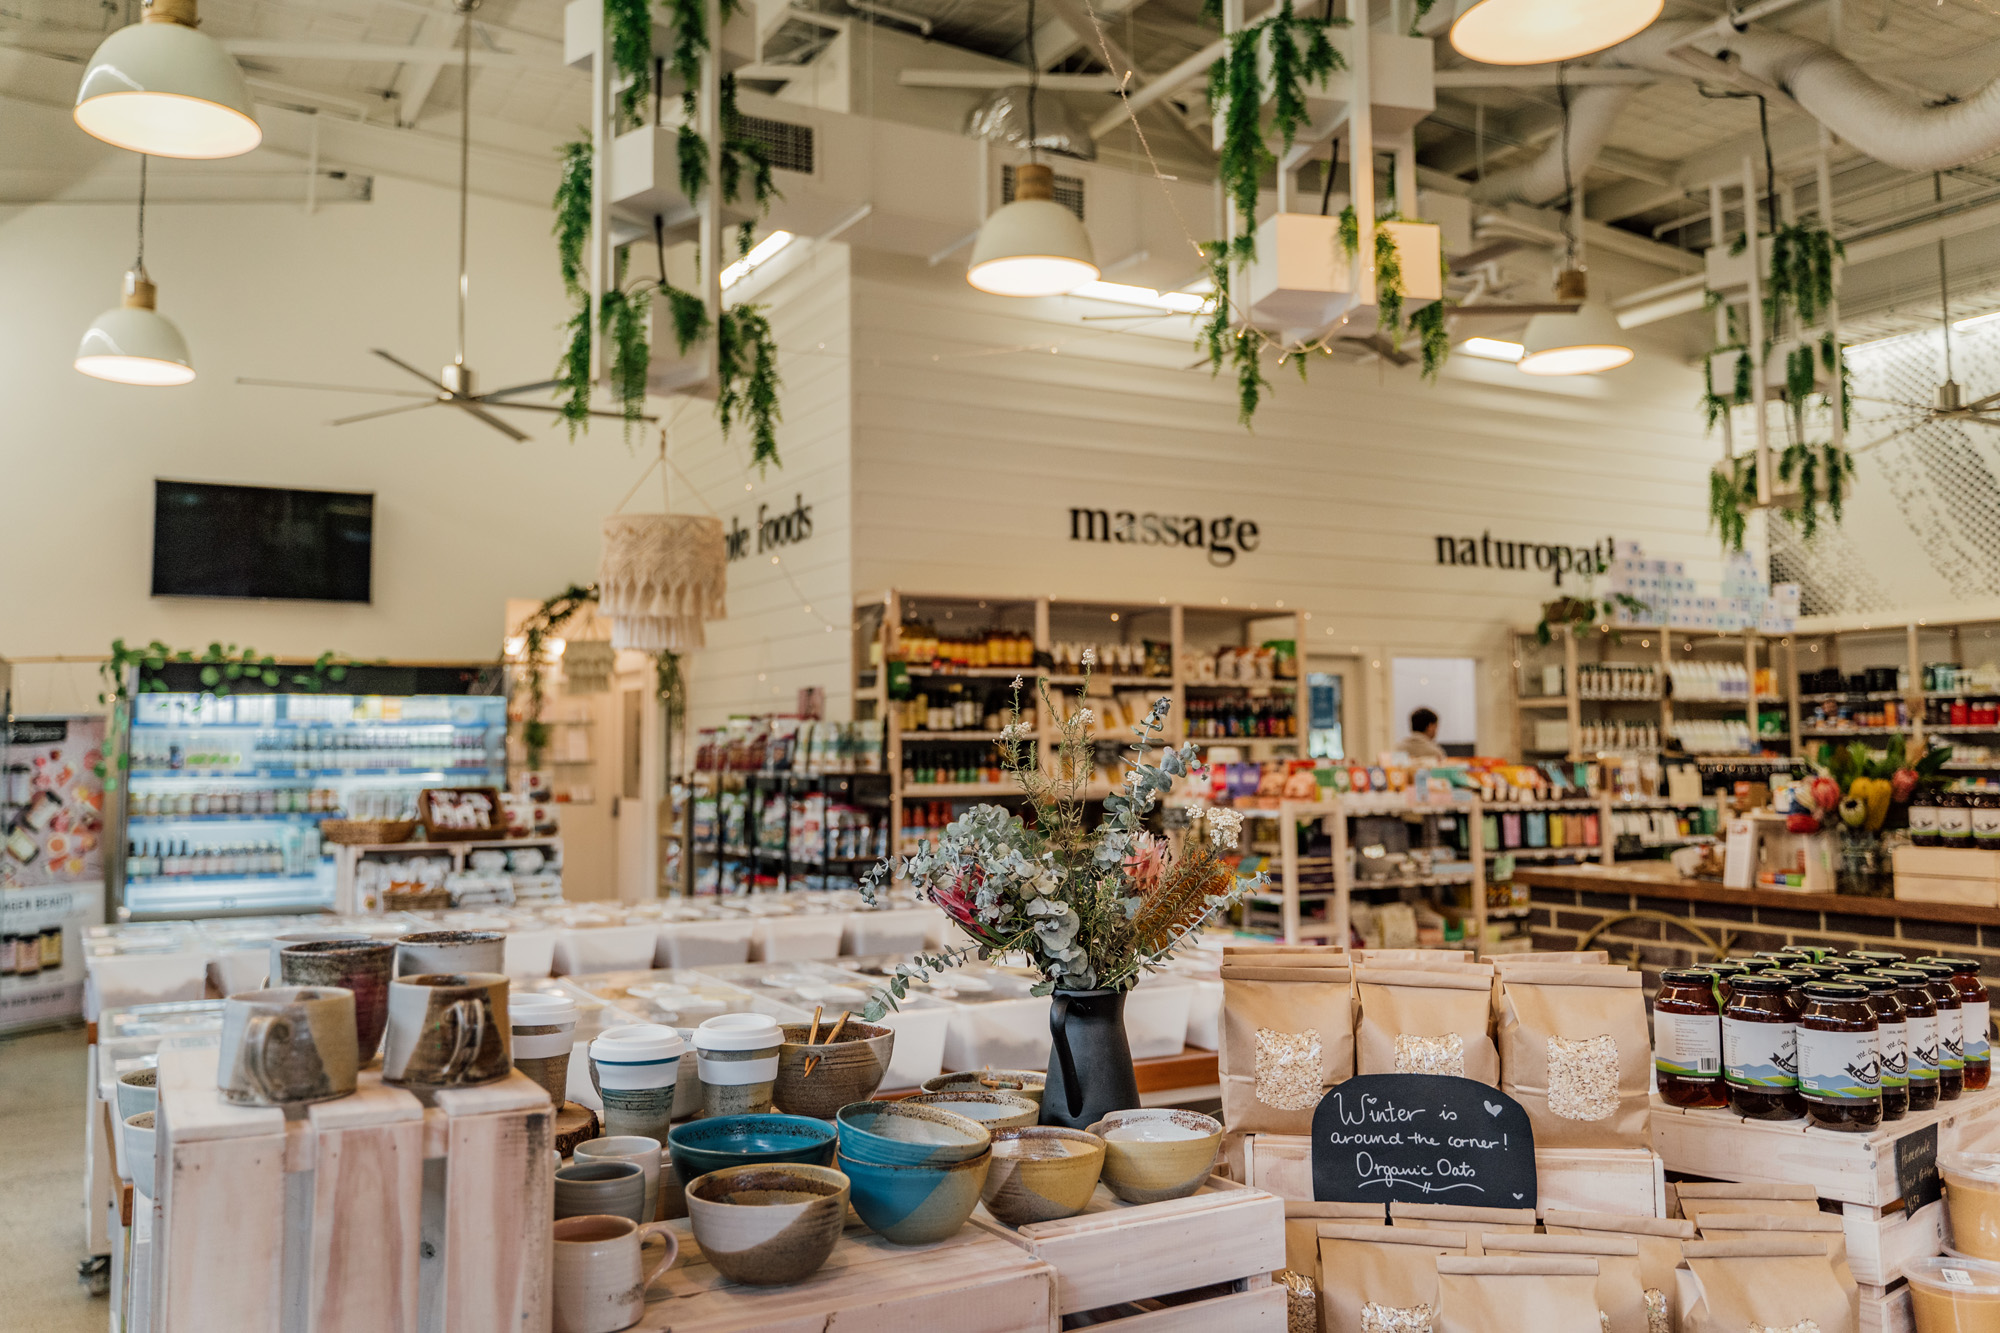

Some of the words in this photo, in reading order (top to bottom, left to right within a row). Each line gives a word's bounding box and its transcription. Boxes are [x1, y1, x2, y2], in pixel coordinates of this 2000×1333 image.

[758, 492, 813, 554] foods
[1068, 507, 1260, 568] massage
[1333, 1092, 1425, 1125] Winter
[1439, 1104, 1457, 1121] is
[1330, 1131, 1404, 1145] around
[1407, 1131, 1440, 1146] the
[1448, 1133, 1509, 1151] corner!
[1356, 1151, 1433, 1188] Organic
[1436, 1158, 1476, 1178] Oats
